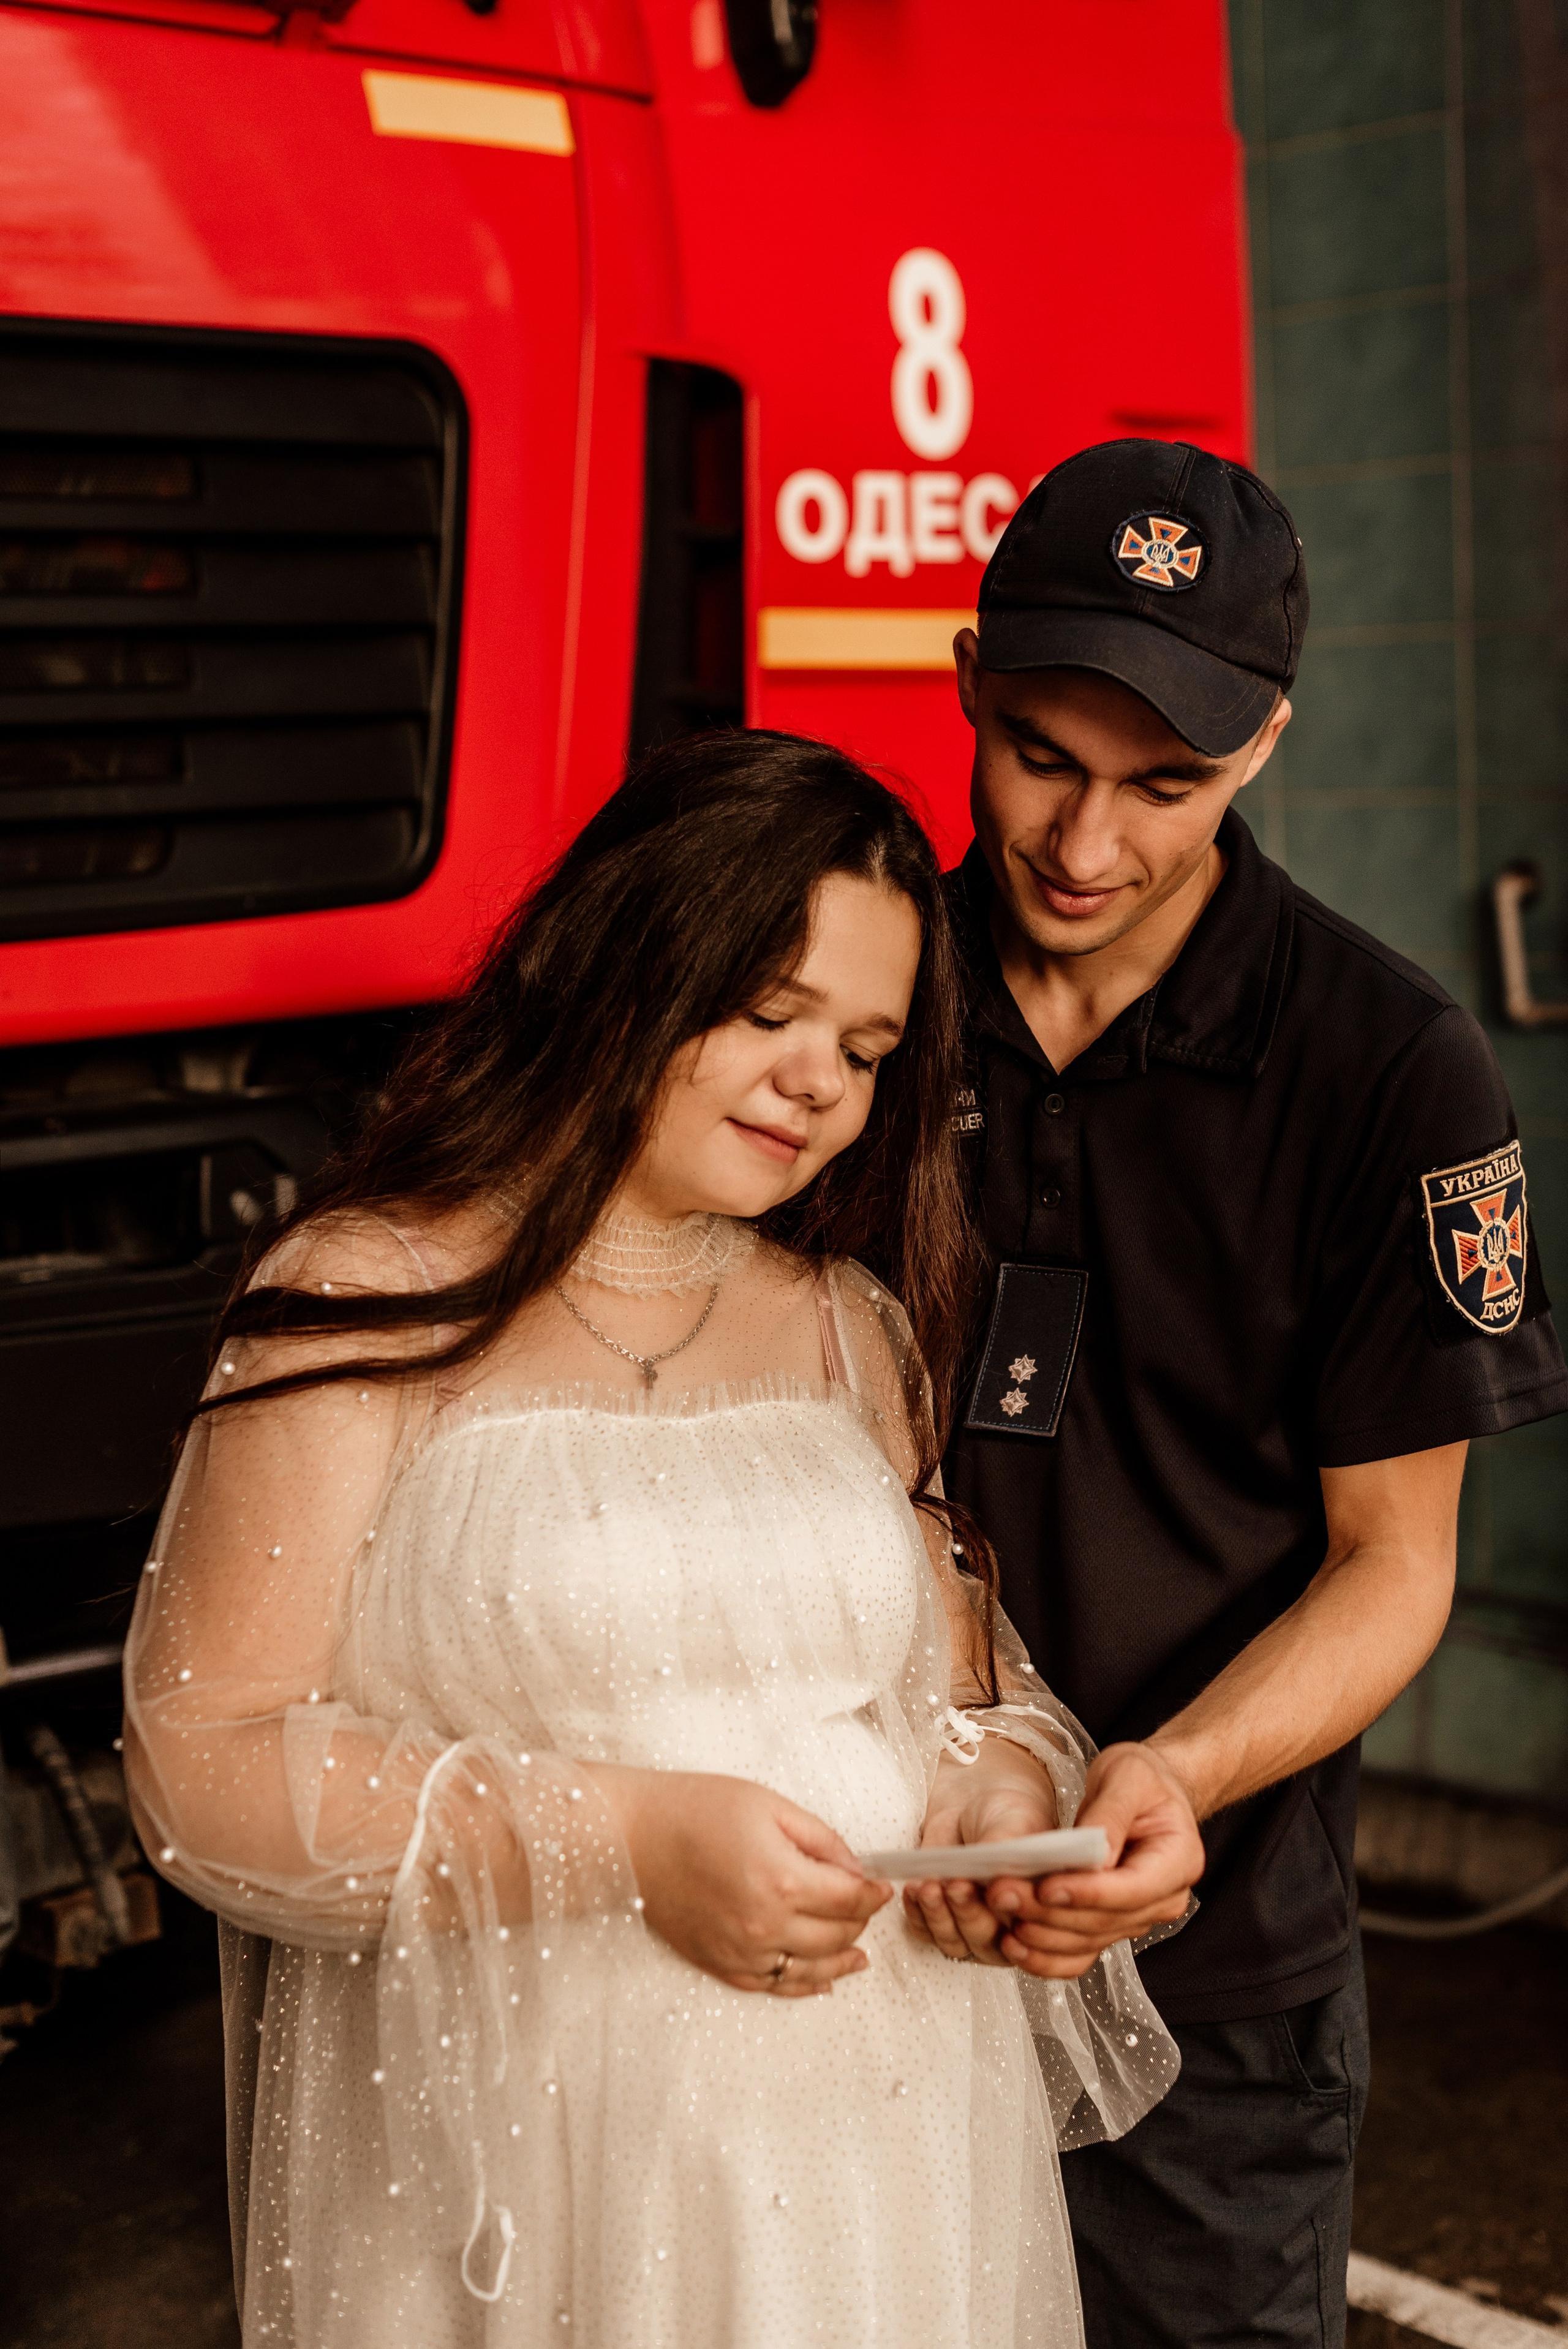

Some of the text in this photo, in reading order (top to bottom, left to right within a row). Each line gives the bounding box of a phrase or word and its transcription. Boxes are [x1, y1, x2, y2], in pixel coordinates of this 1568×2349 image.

[888, 246, 974, 462] 8
[775, 467, 1047, 578] ОДЕС
[1440, 1153, 1518, 1197] УКРАЇНА
[1479, 1289, 1520, 1321] ДСНС
